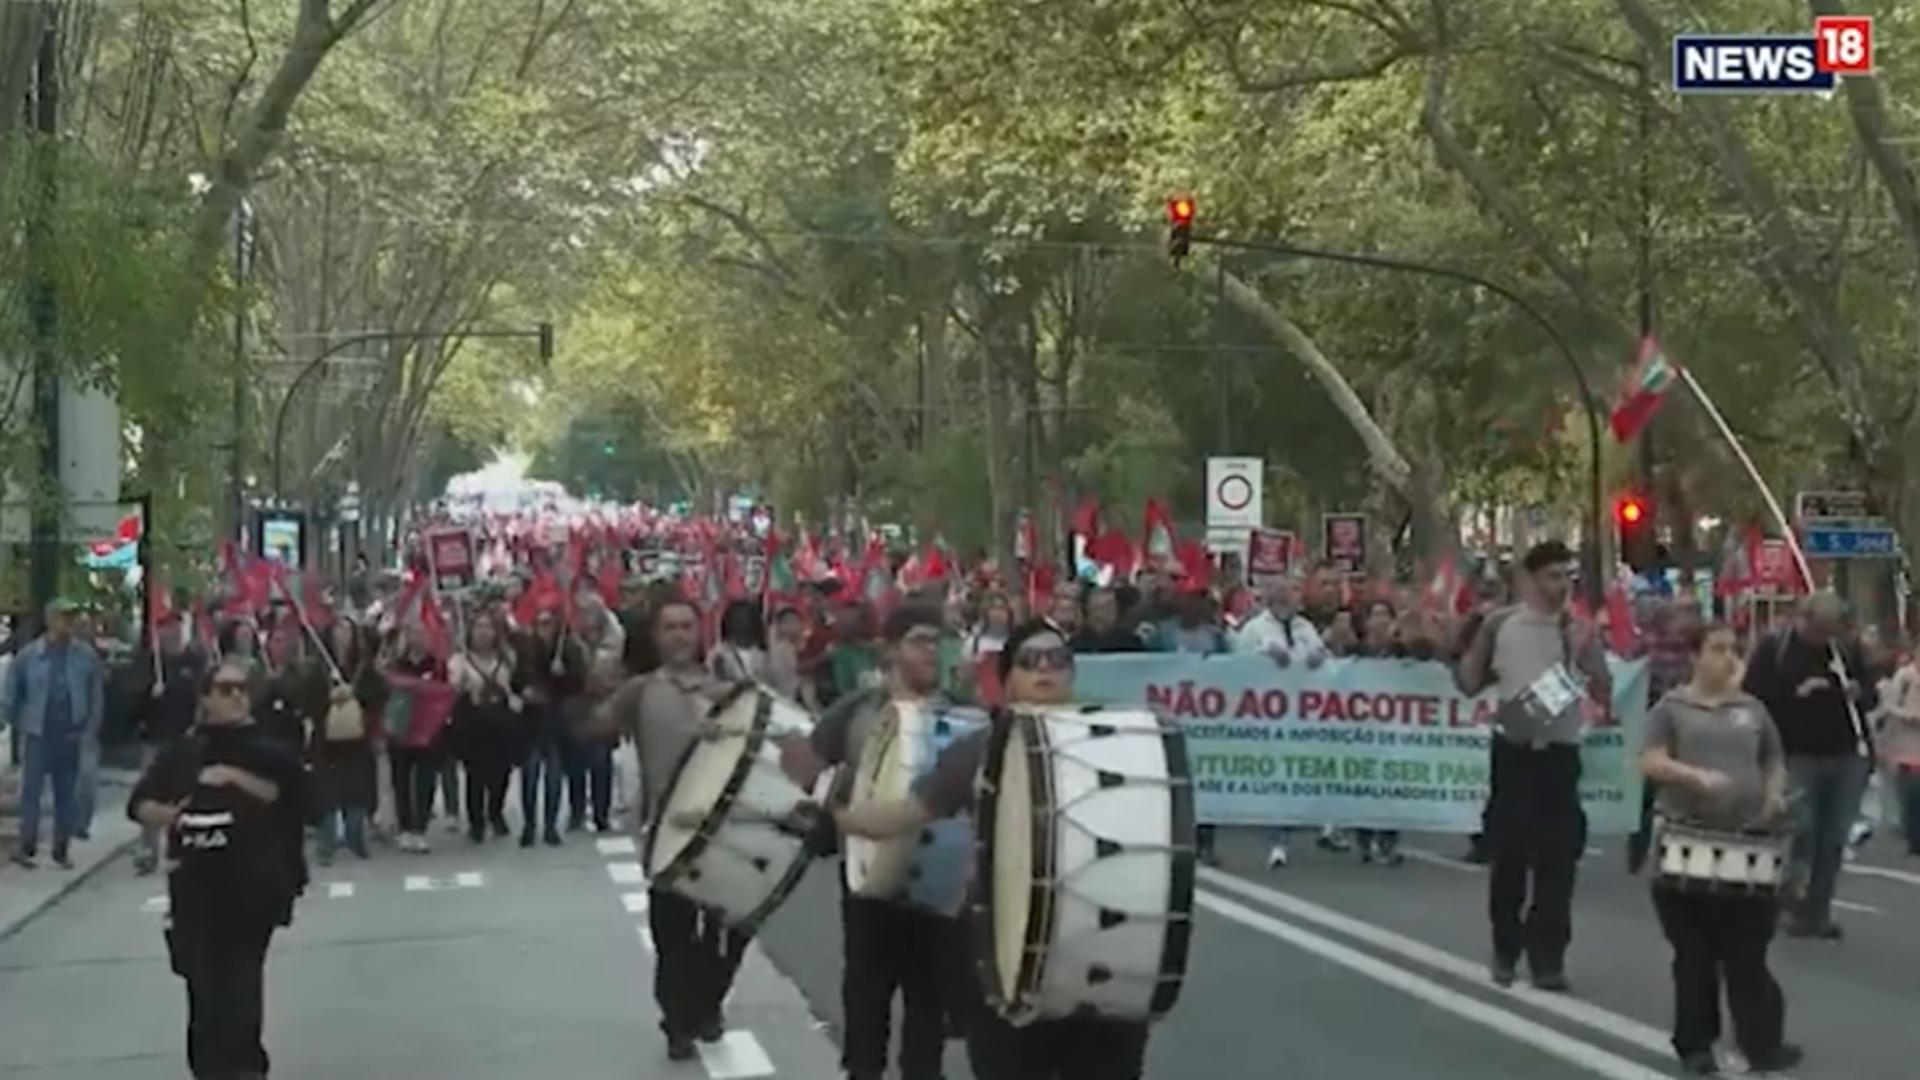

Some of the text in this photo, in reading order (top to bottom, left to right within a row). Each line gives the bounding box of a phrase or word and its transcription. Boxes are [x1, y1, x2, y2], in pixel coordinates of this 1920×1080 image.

[1146, 680, 1225, 719] NÃO
[1235, 688, 1288, 720] AO
[1299, 690, 1440, 726] PACOTE
[1197, 755, 1276, 777] TURO
[1282, 756, 1338, 780] TEM
[1343, 758, 1377, 781] DE
[1383, 760, 1431, 784] SER
